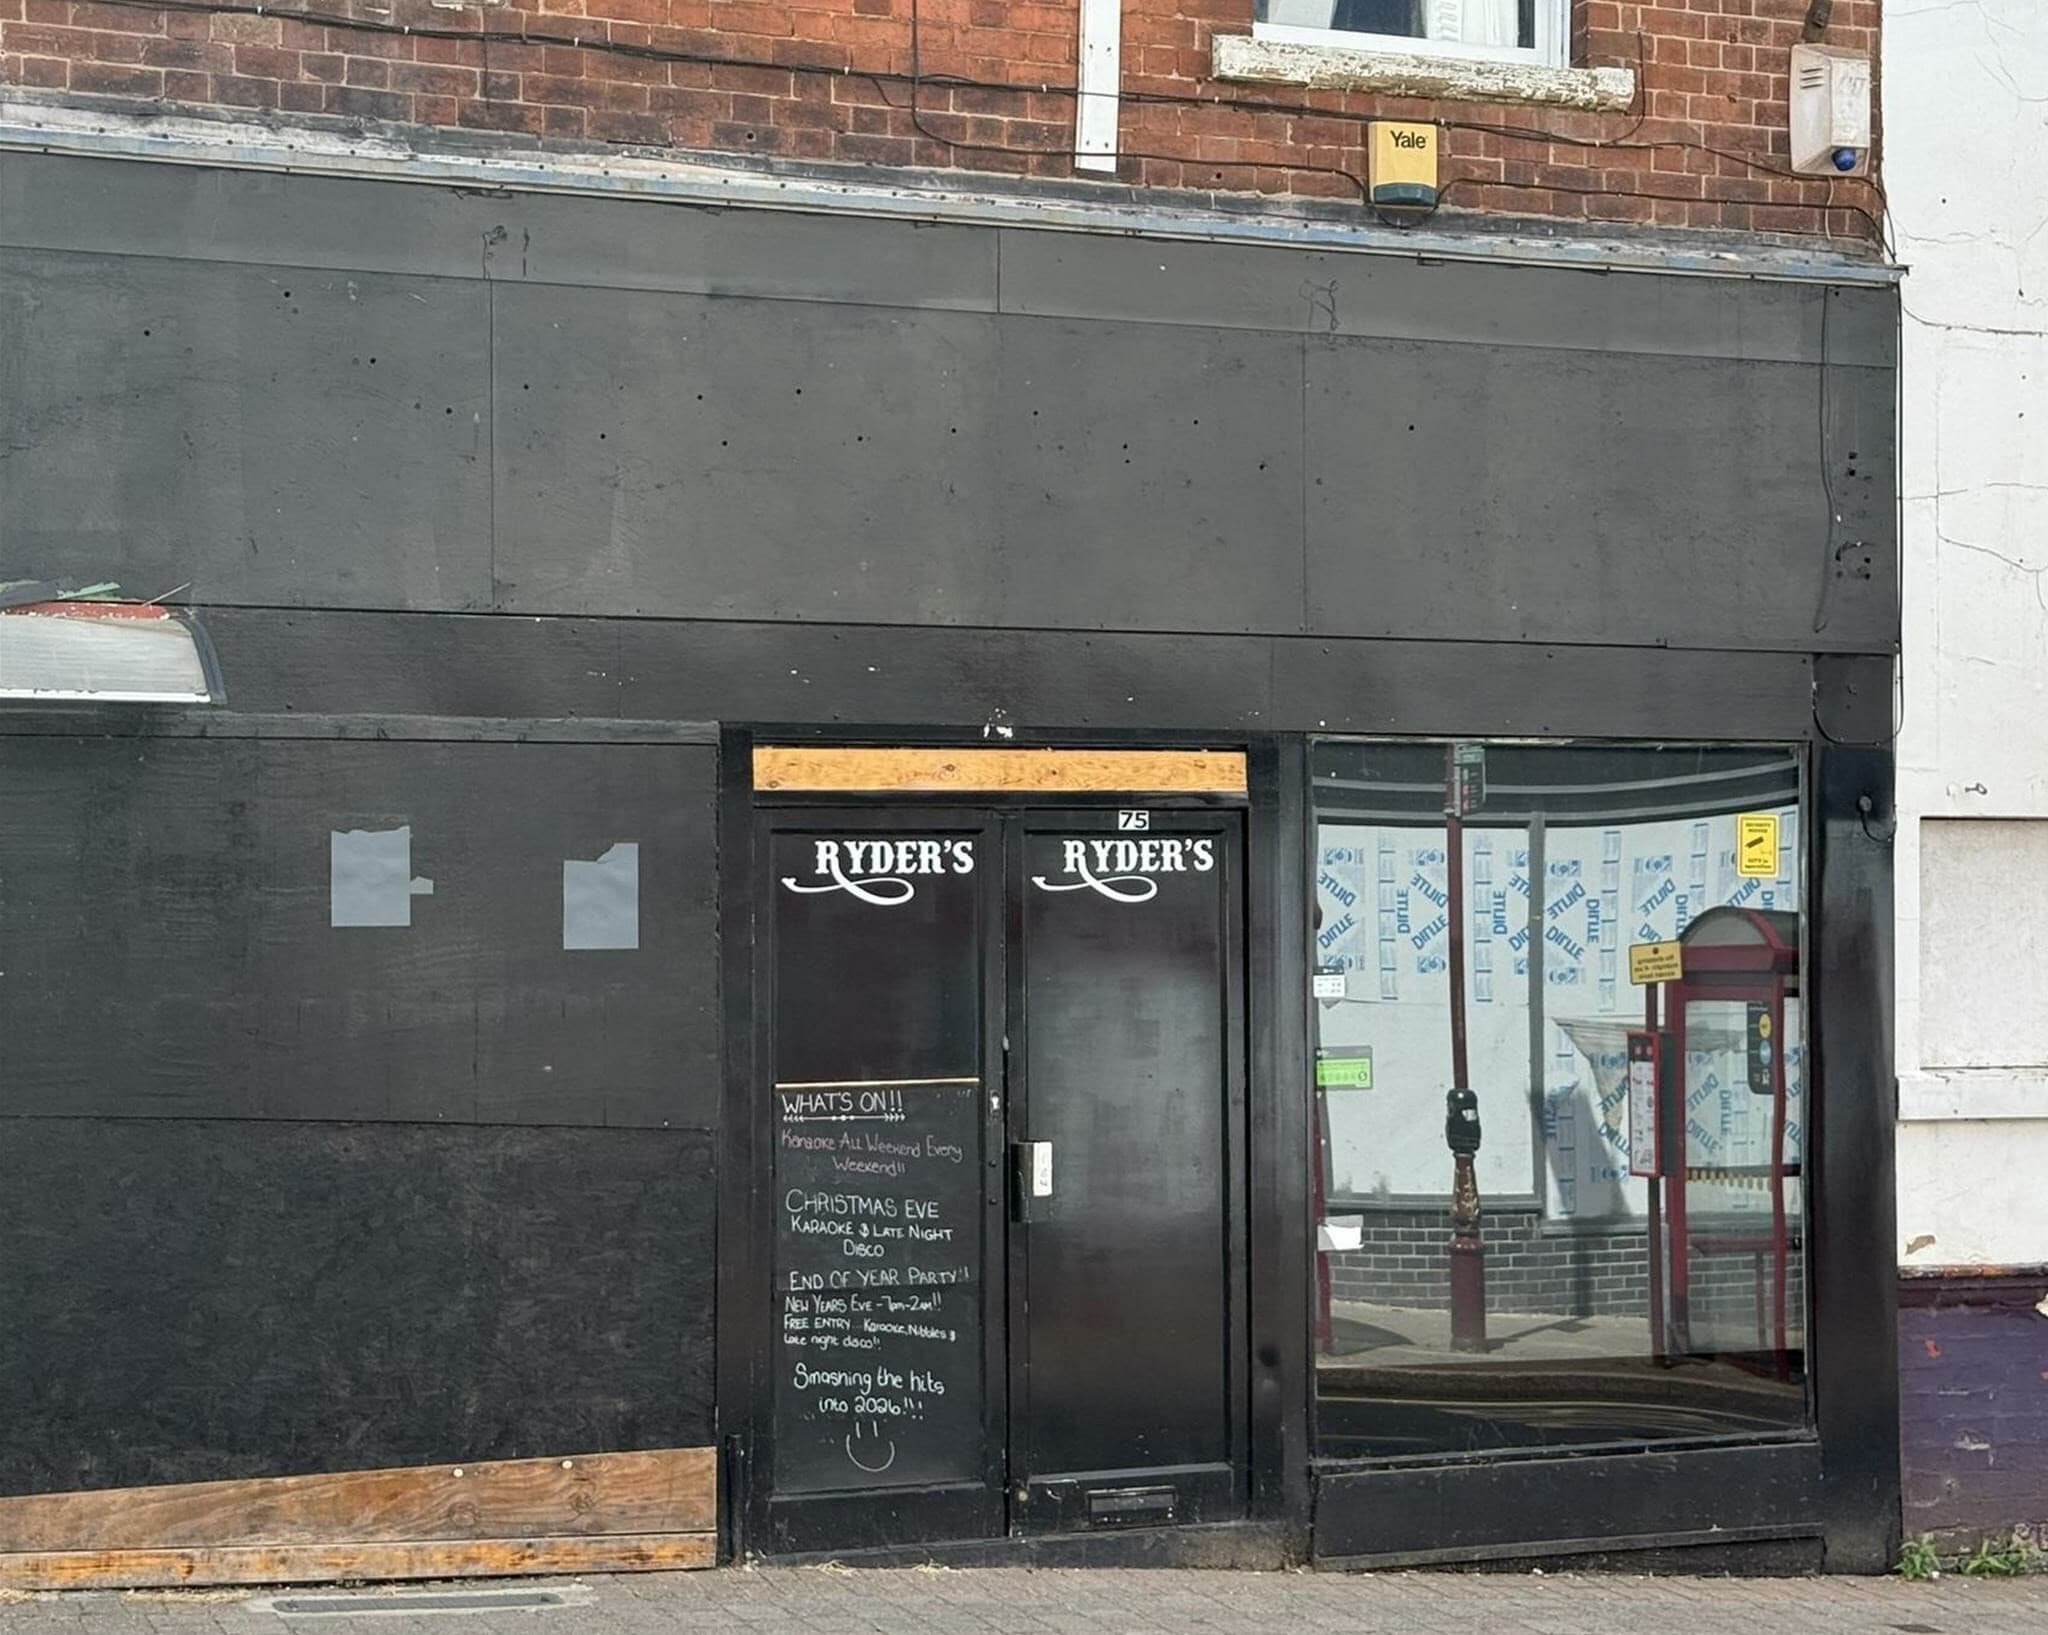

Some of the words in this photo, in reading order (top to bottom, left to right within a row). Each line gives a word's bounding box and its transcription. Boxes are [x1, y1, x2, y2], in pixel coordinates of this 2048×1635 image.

[1390, 129, 1426, 149] Yale
[1121, 812, 1148, 829] 75
[860, 1089, 903, 1112] ON!!
[785, 1188, 898, 1218] CHRISTMAS
[905, 1199, 940, 1219] EVE
[789, 1270, 824, 1292] END
[830, 1270, 851, 1290] OF
[856, 1268, 900, 1287] YEAR
[793, 1362, 872, 1396] Smashing
[876, 1365, 903, 1389] the
[910, 1369, 946, 1396] hits
